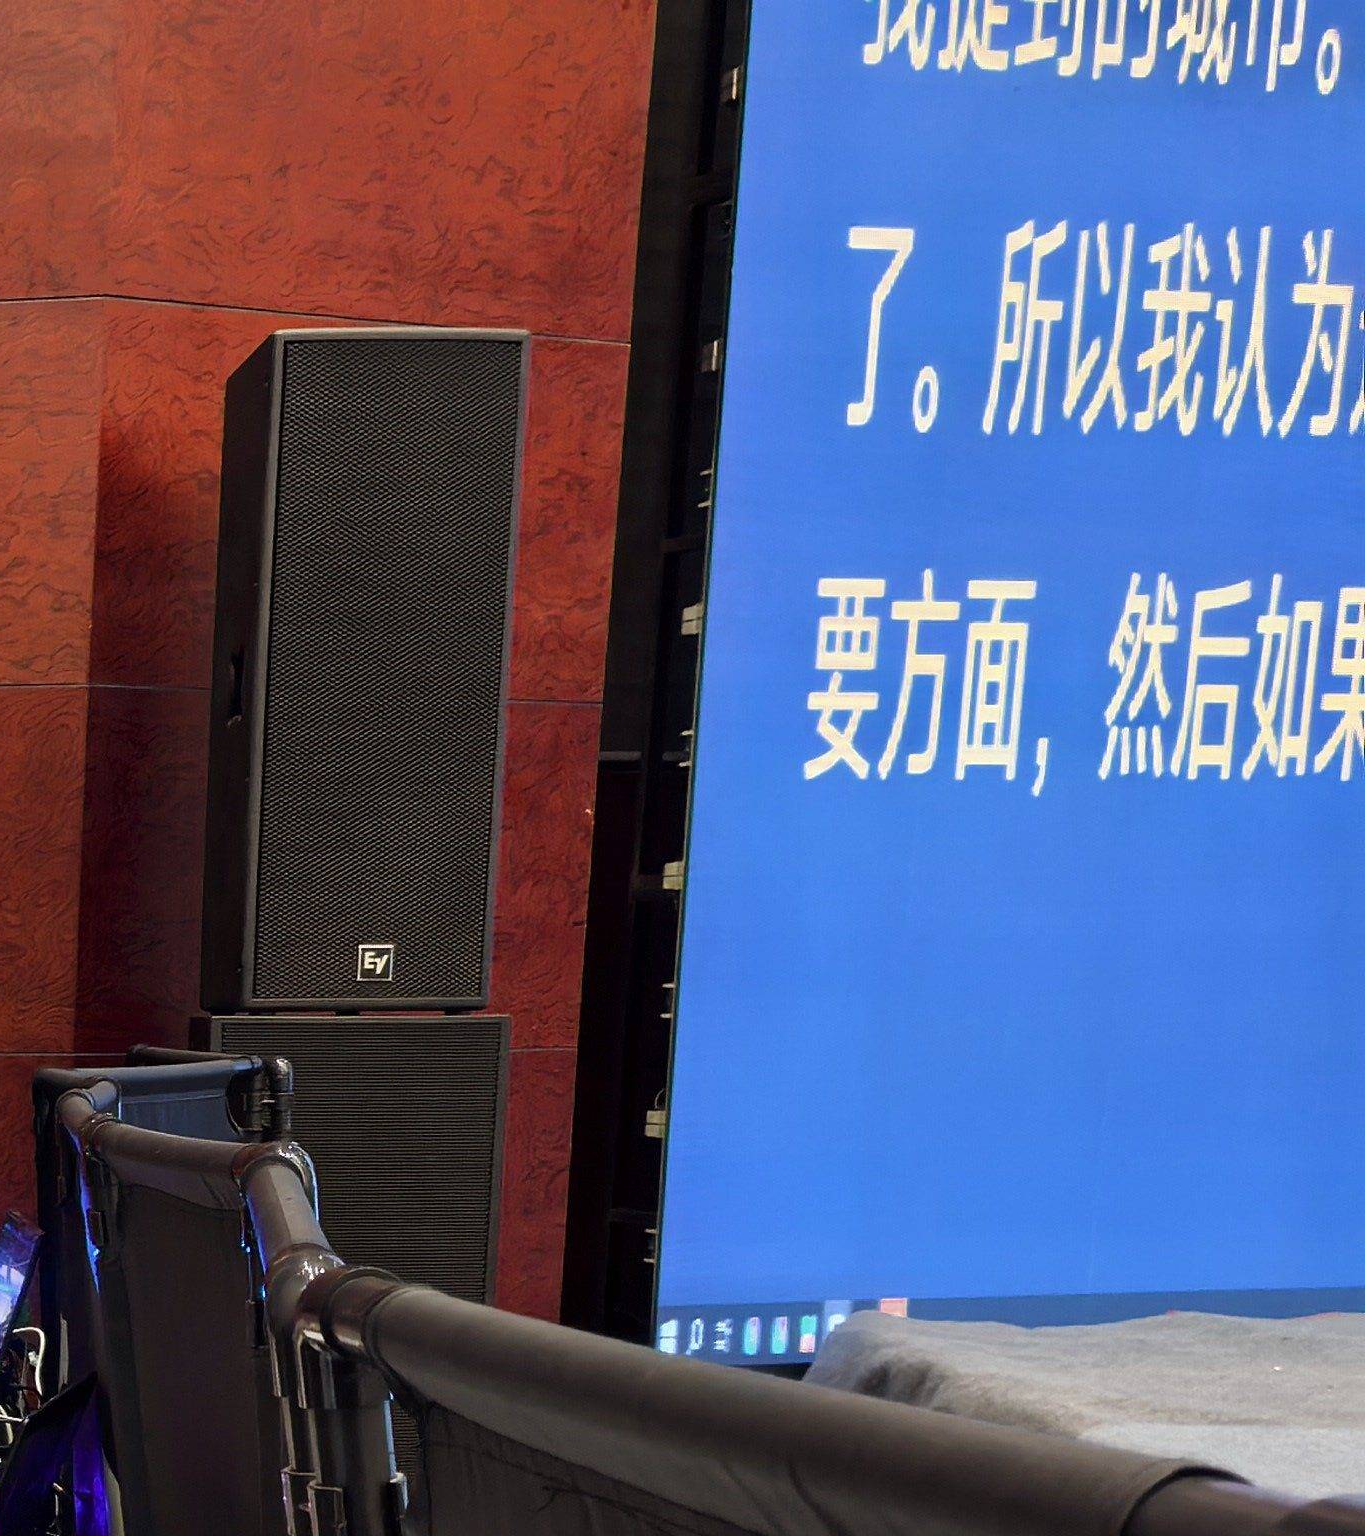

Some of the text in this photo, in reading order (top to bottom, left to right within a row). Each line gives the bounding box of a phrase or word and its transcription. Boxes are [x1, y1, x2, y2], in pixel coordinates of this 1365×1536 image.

[846, 220, 1365, 438] 了。所以我认为
